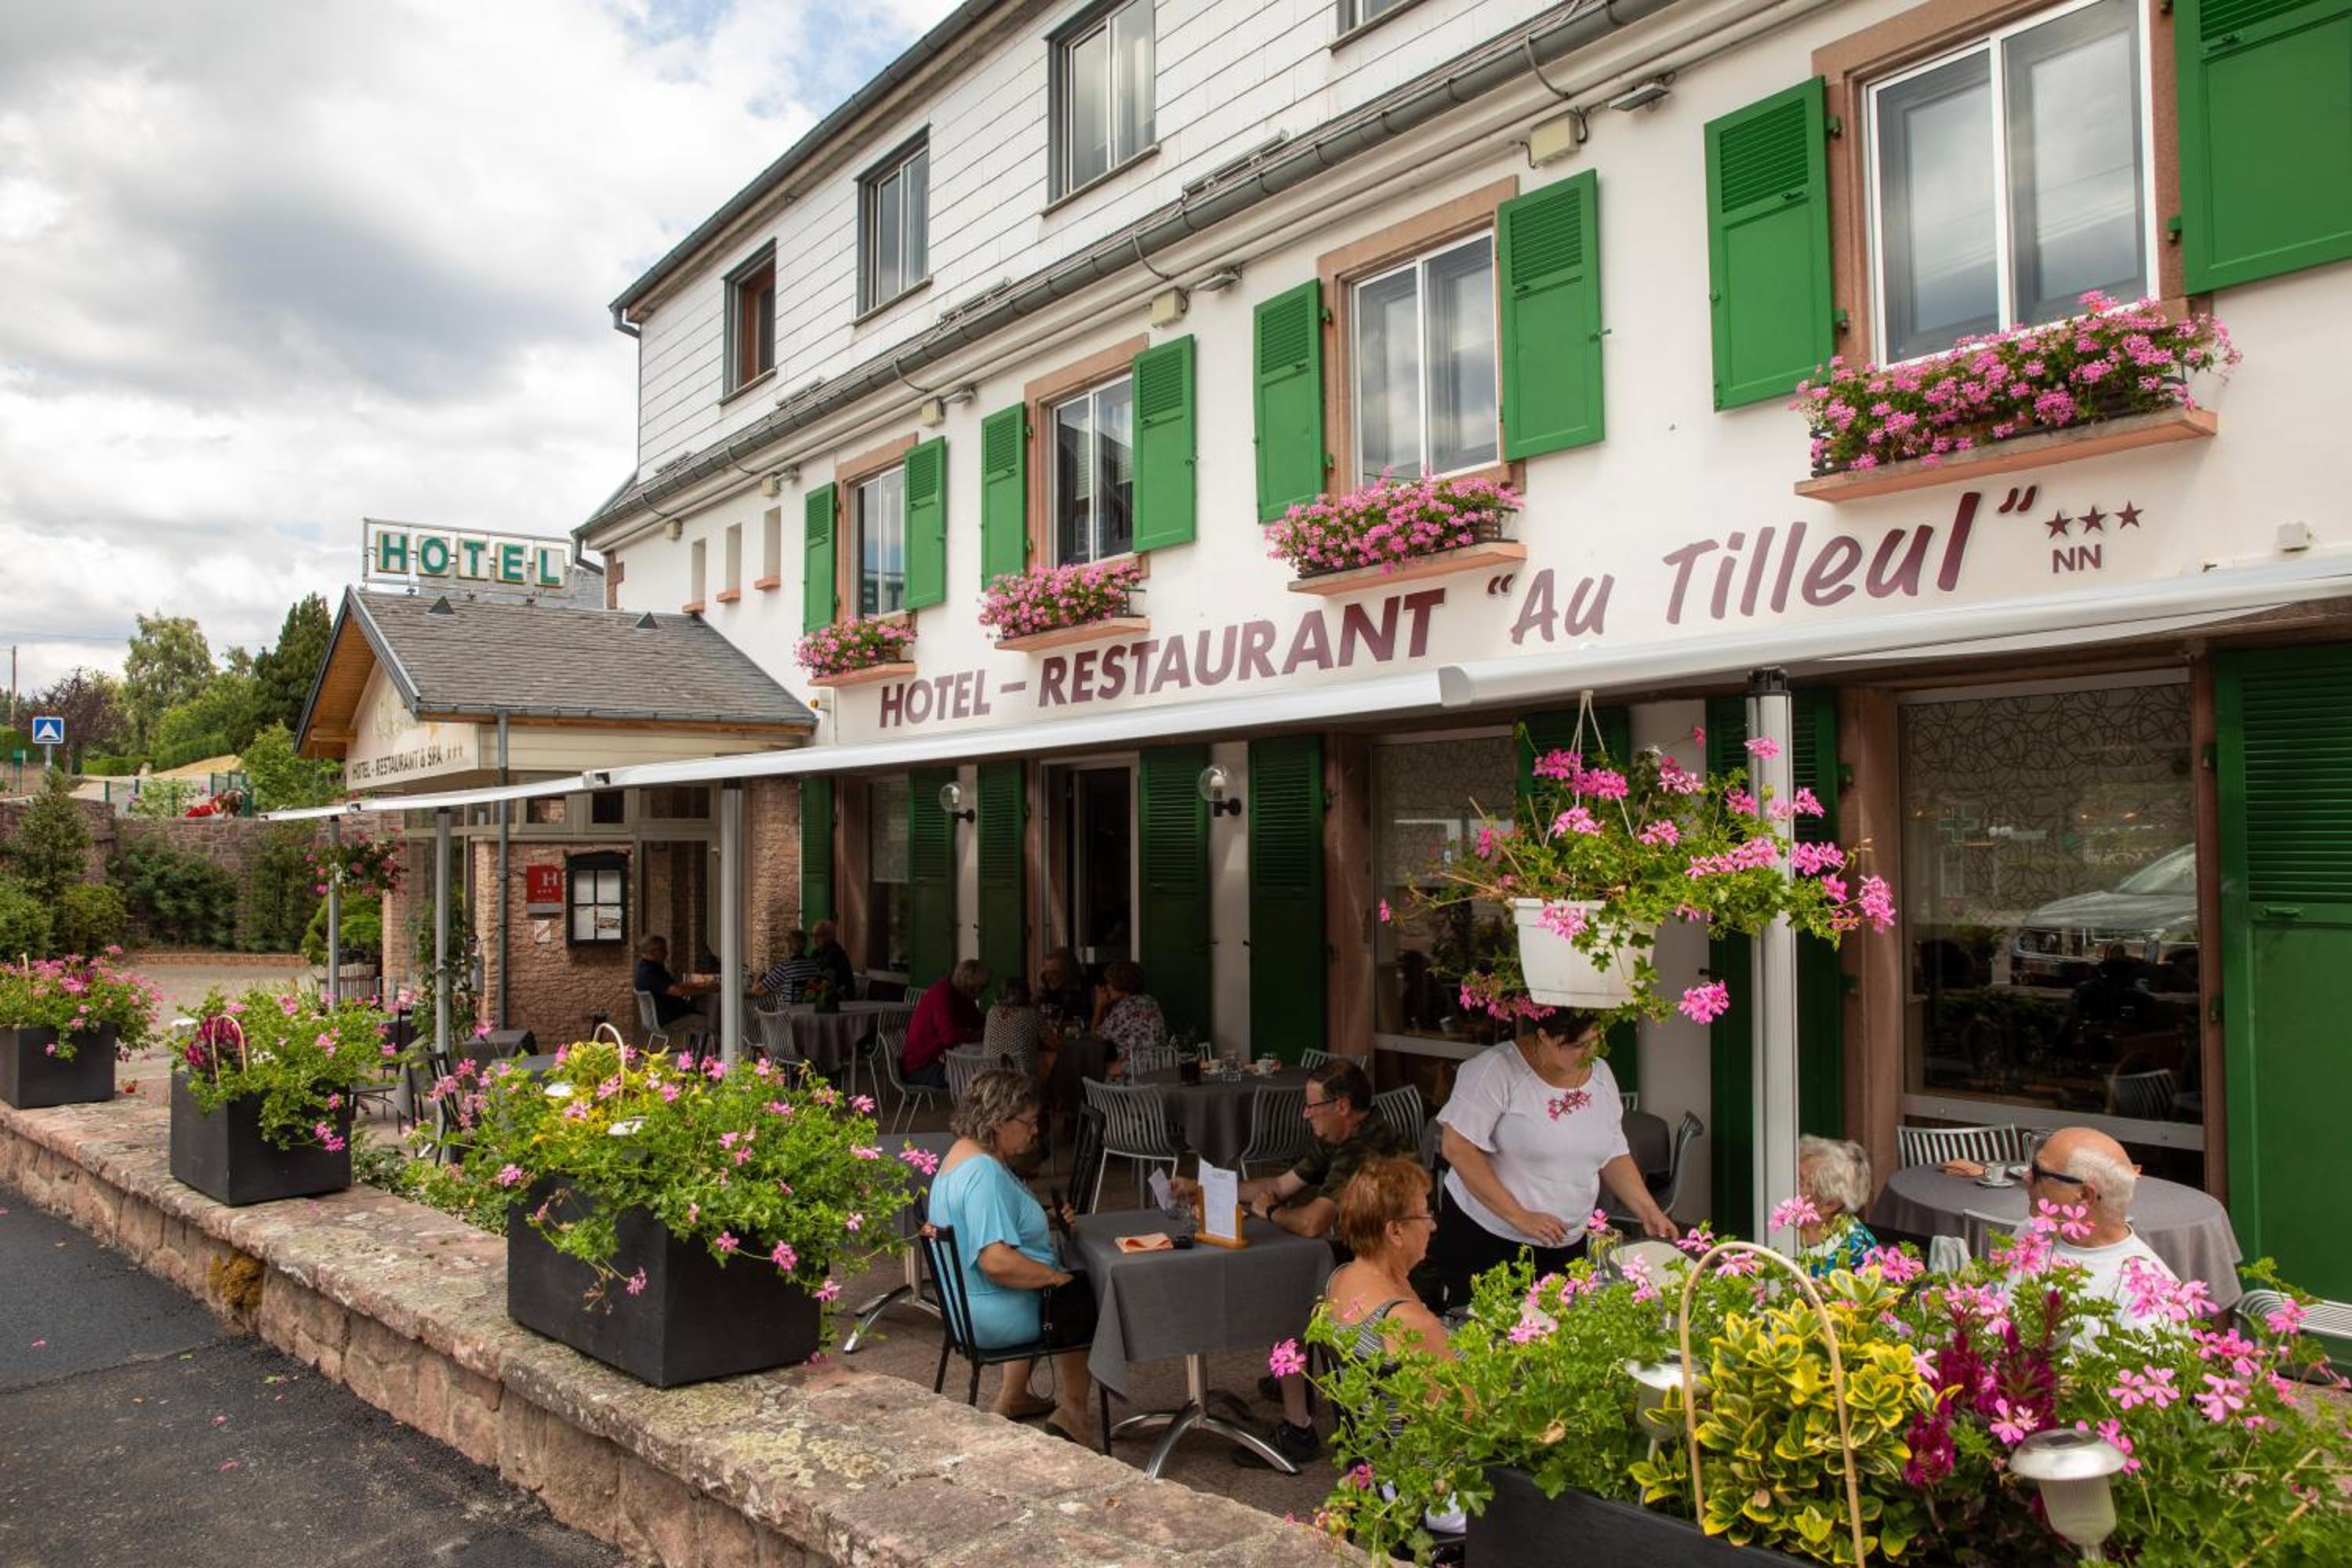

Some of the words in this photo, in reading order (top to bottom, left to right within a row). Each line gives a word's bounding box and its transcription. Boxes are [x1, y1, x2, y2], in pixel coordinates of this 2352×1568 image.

[381, 532, 561, 585] HOTEL
[2052, 543, 2103, 574] NN
[879, 669, 991, 728] HOTEL
[1037, 587, 1446, 707] RESTAURANT
[352, 760, 371, 779] HOTEL
[376, 750, 419, 777] RESTAURANT
[427, 745, 443, 767] SPA
[543, 871, 557, 887] H
